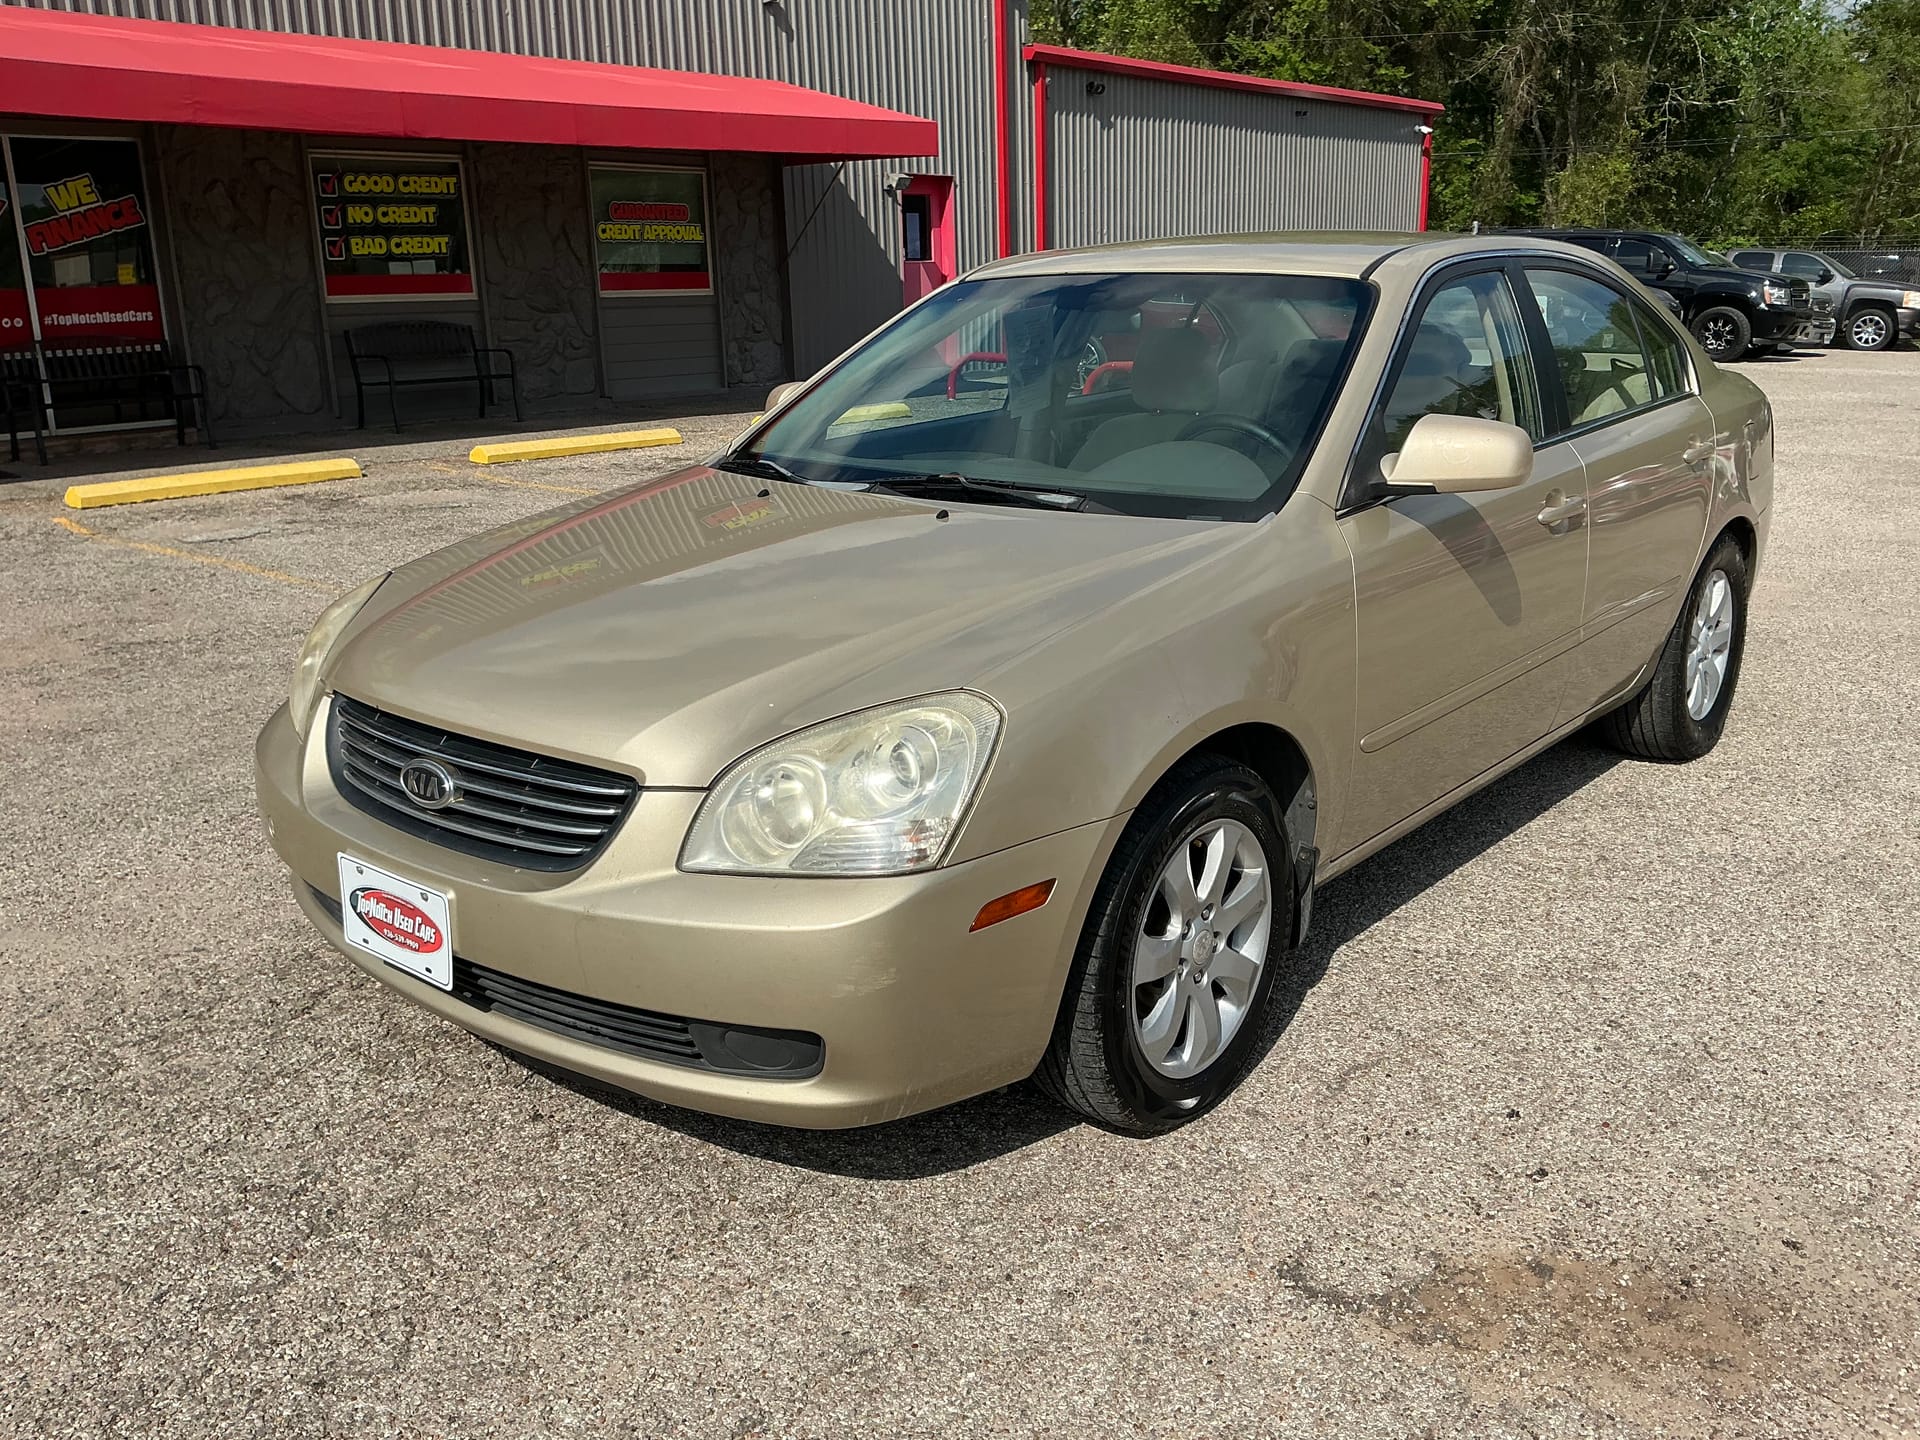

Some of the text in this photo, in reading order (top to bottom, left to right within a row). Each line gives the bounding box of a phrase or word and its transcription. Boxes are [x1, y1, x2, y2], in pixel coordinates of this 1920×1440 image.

[46, 176, 98, 211] WE
[343, 175, 457, 194] GOOD CREDIT
[347, 206, 437, 224] NO CREDIT
[610, 202, 688, 220] GUARANTEED
[26, 195, 144, 254] FINANCE
[597, 224, 704, 241] CREDIT APPROVAL
[351, 236, 449, 255] BAD CREDIT
[44, 310, 153, 326] #TopNotchUsedCars
[407, 769, 440, 799] KIA
